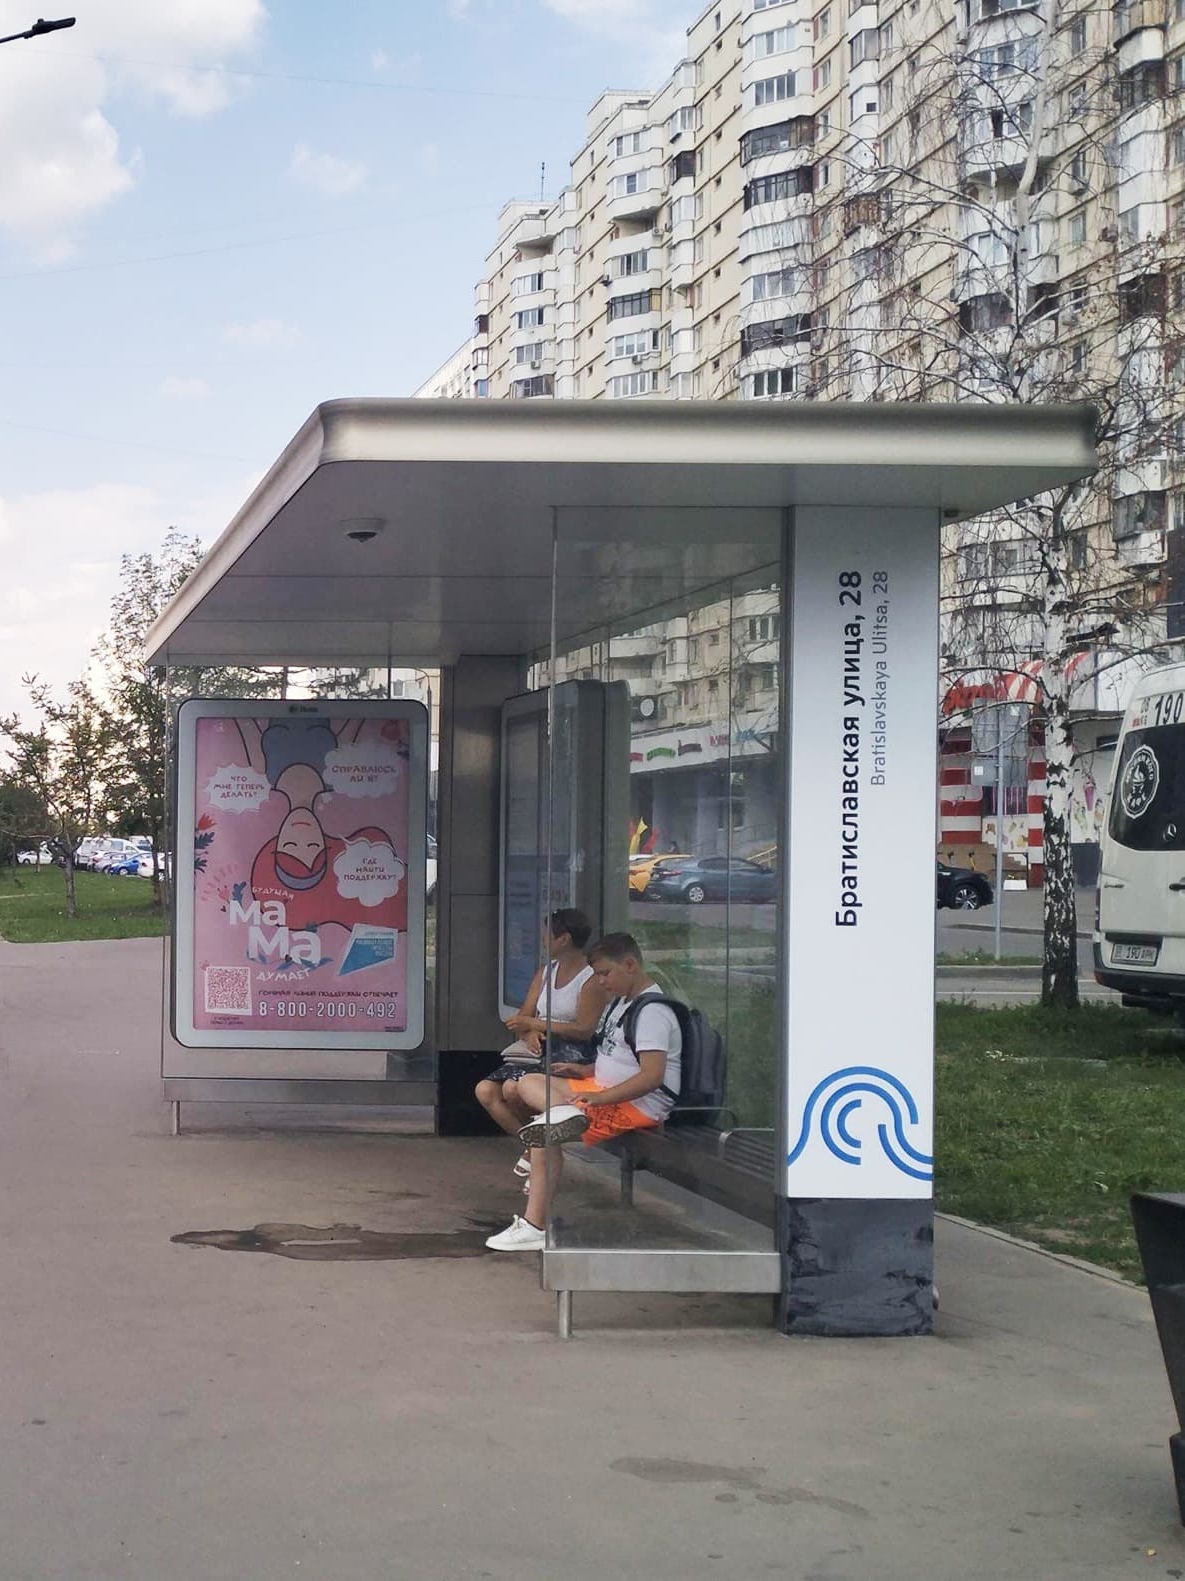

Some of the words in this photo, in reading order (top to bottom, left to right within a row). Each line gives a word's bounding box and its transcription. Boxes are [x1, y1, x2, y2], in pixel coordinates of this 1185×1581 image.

[839, 571, 862, 606] 28
[872, 571, 888, 594] 28
[871, 600, 890, 654] Ulitsa,
[843, 614, 866, 707] улица,
[870, 661, 890, 786] Bratislavskaya
[230, 775, 248, 783] ЧТО
[835, 716, 862, 927] Братиславская
[256, 969, 311, 983] ДУМАЕТ
[258, 1001, 397, 1018] 8-800-2000-492
